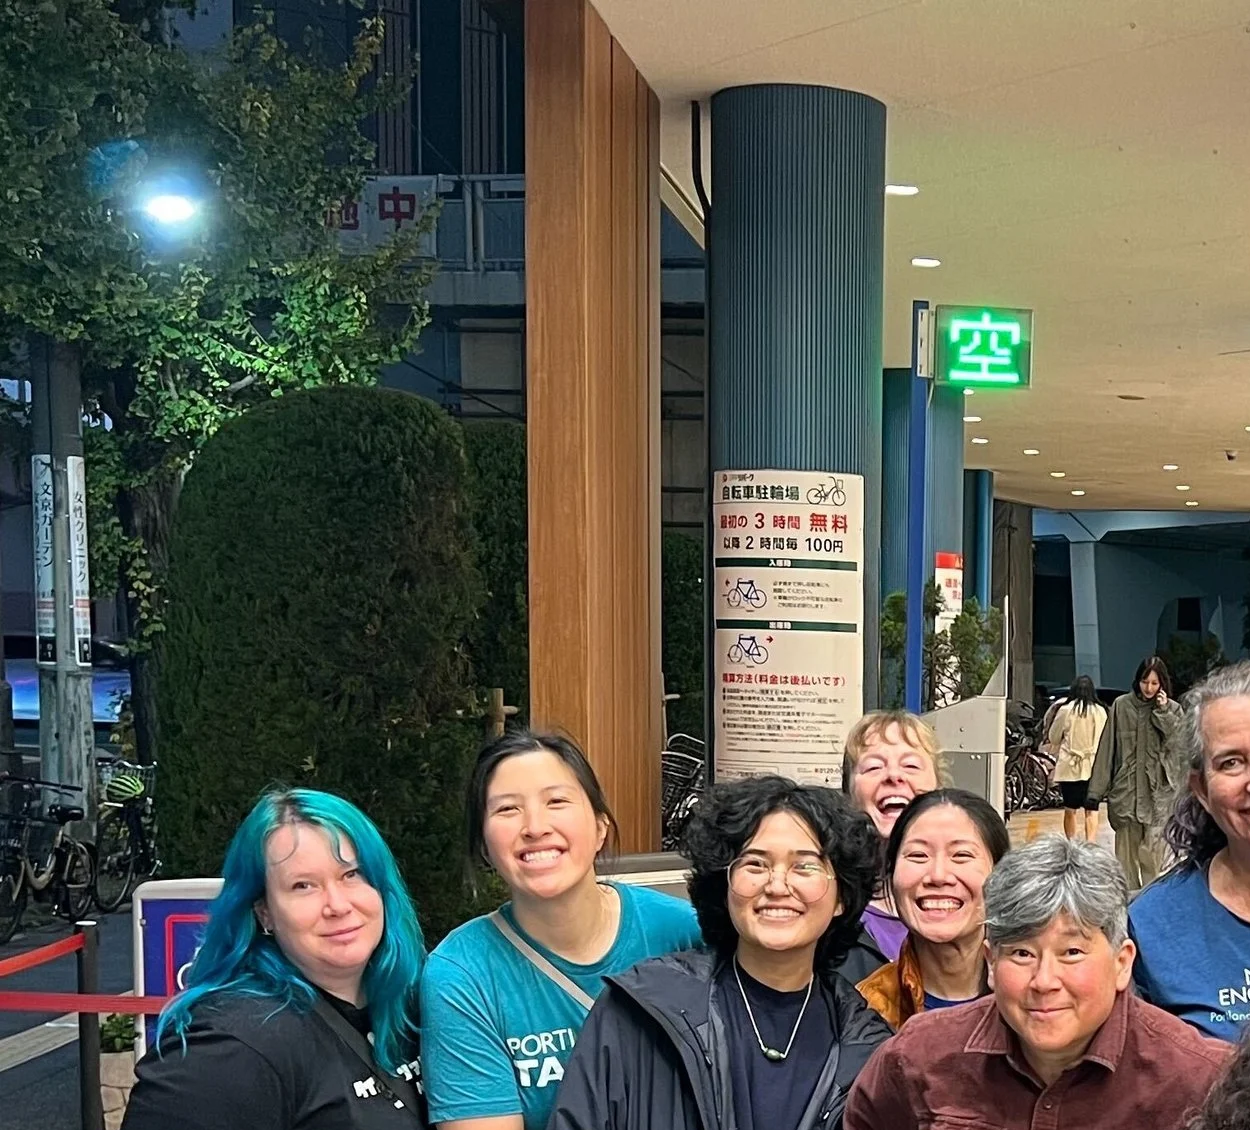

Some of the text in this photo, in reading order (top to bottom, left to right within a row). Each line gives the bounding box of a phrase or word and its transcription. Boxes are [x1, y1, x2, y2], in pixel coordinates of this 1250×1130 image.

[948, 311, 1020, 384] 空
[722, 485, 800, 501] 自転車駐輪場
[754, 512, 765, 530] 3
[809, 512, 848, 534] 無料
[745, 535, 754, 550] 2
[805, 537, 844, 553] 100円
